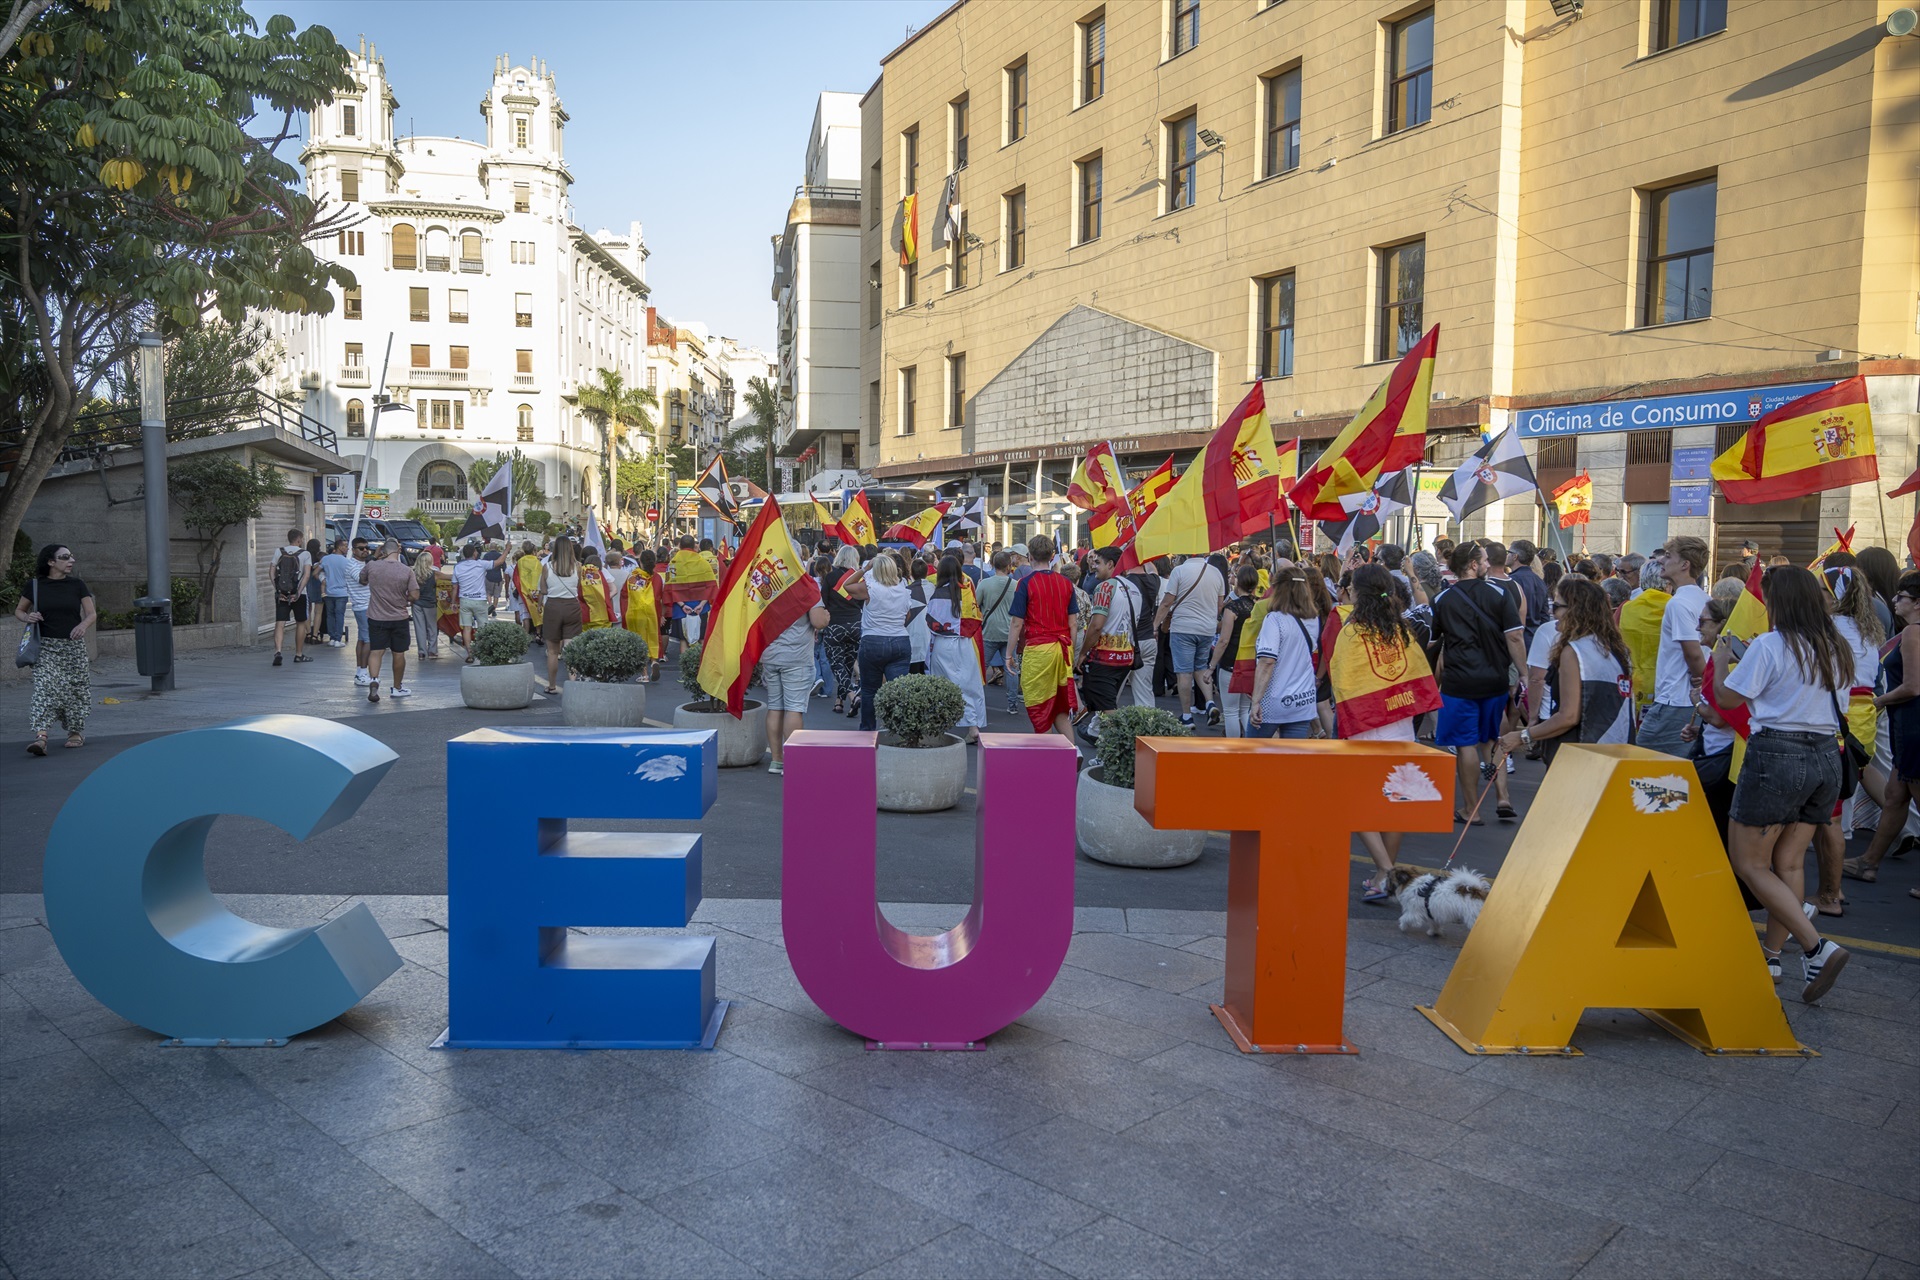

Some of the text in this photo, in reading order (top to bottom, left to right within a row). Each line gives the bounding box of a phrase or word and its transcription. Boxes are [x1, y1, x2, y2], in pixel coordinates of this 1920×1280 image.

[1528, 401, 1737, 433] Oficina de Consumo
[975, 454, 999, 465] MERCADO
[1004, 450, 1031, 460] CENTRAL
[1038, 448, 1047, 458] DE
[1054, 445, 1085, 456] ABASTOS
[1113, 440, 1139, 450] CEUTA
[44, 713, 1821, 1056] CEUTA
